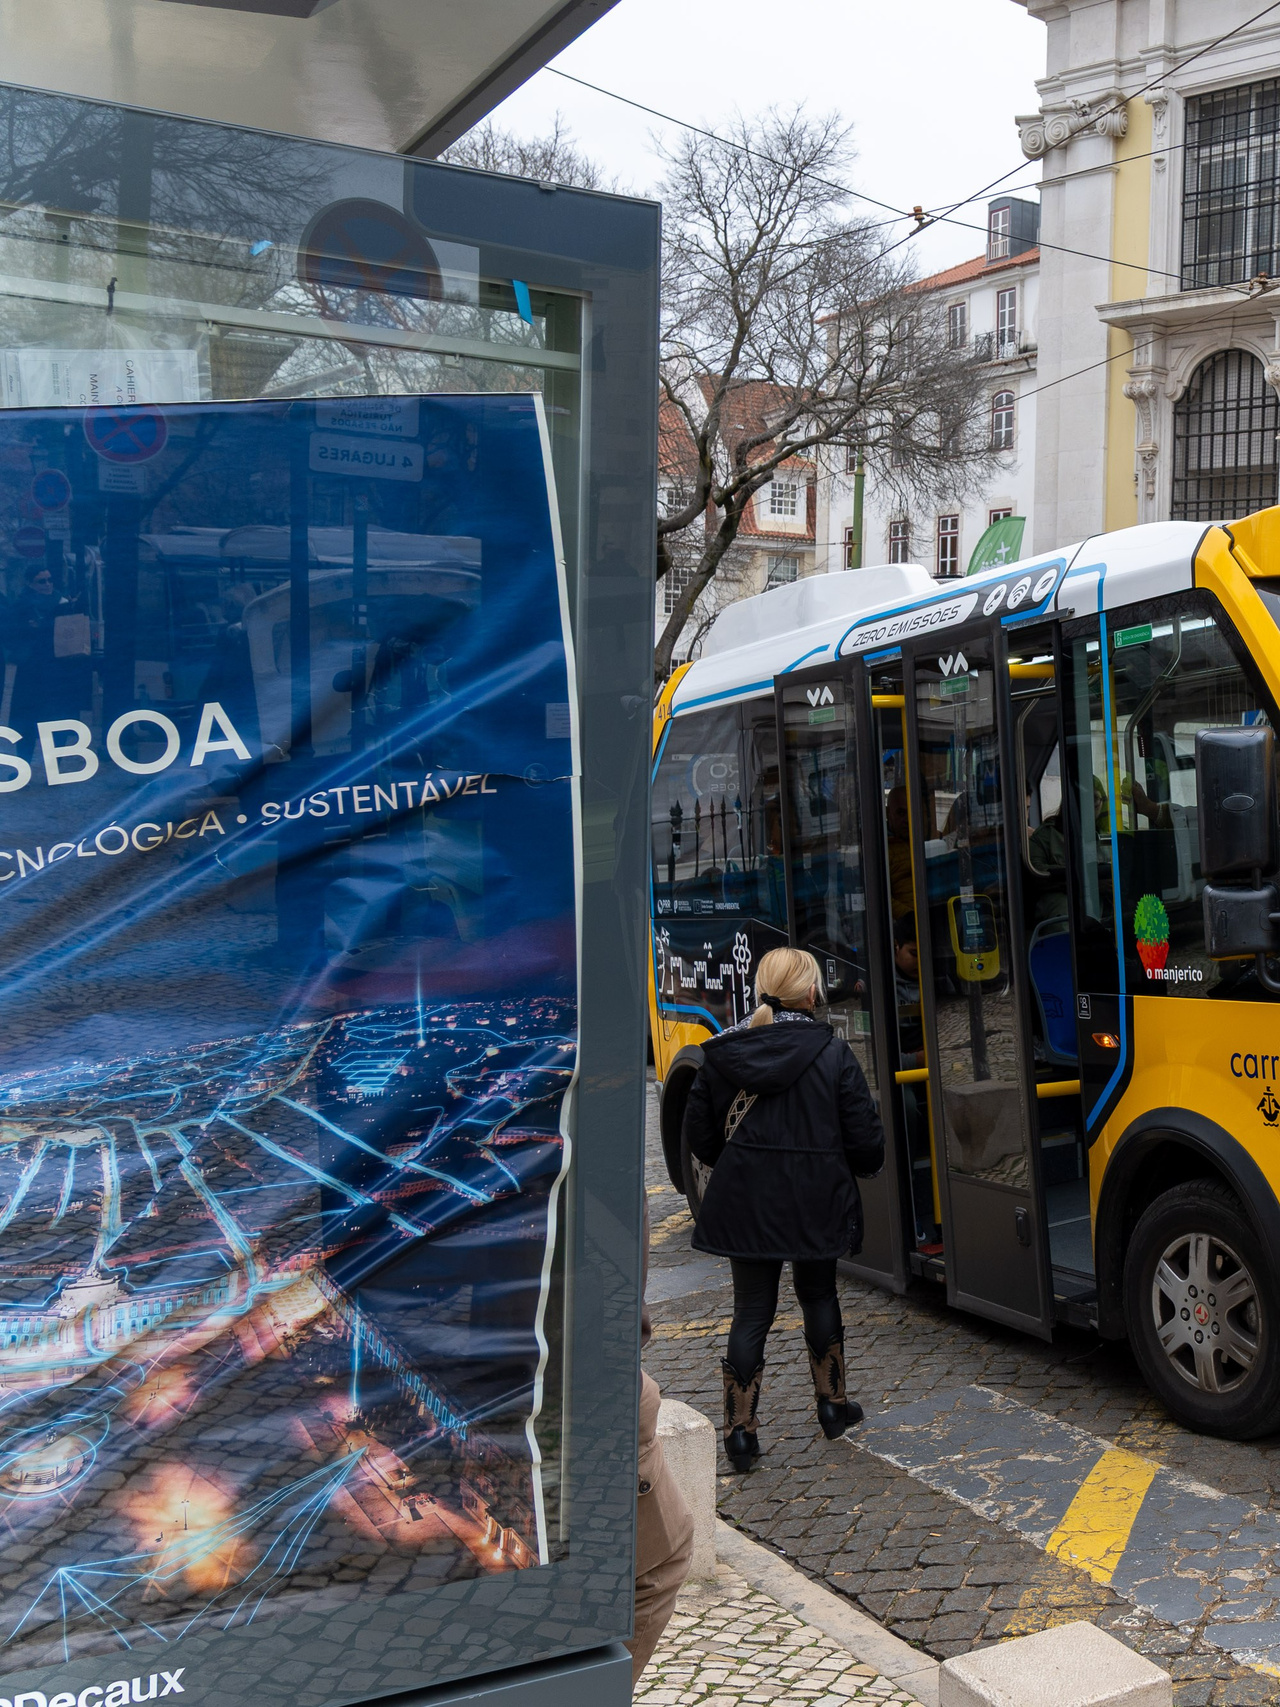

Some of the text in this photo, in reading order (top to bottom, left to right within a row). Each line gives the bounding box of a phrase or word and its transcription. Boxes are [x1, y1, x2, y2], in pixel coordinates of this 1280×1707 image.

[852, 626, 885, 648] ZERO
[658, 703, 672, 721] 414
[0, 702, 252, 793] SBOA
[261, 772, 497, 826] SUSTENTÁVEL
[1146, 966, 1203, 983] o manjerico
[0, 1667, 186, 1707] Decaux
